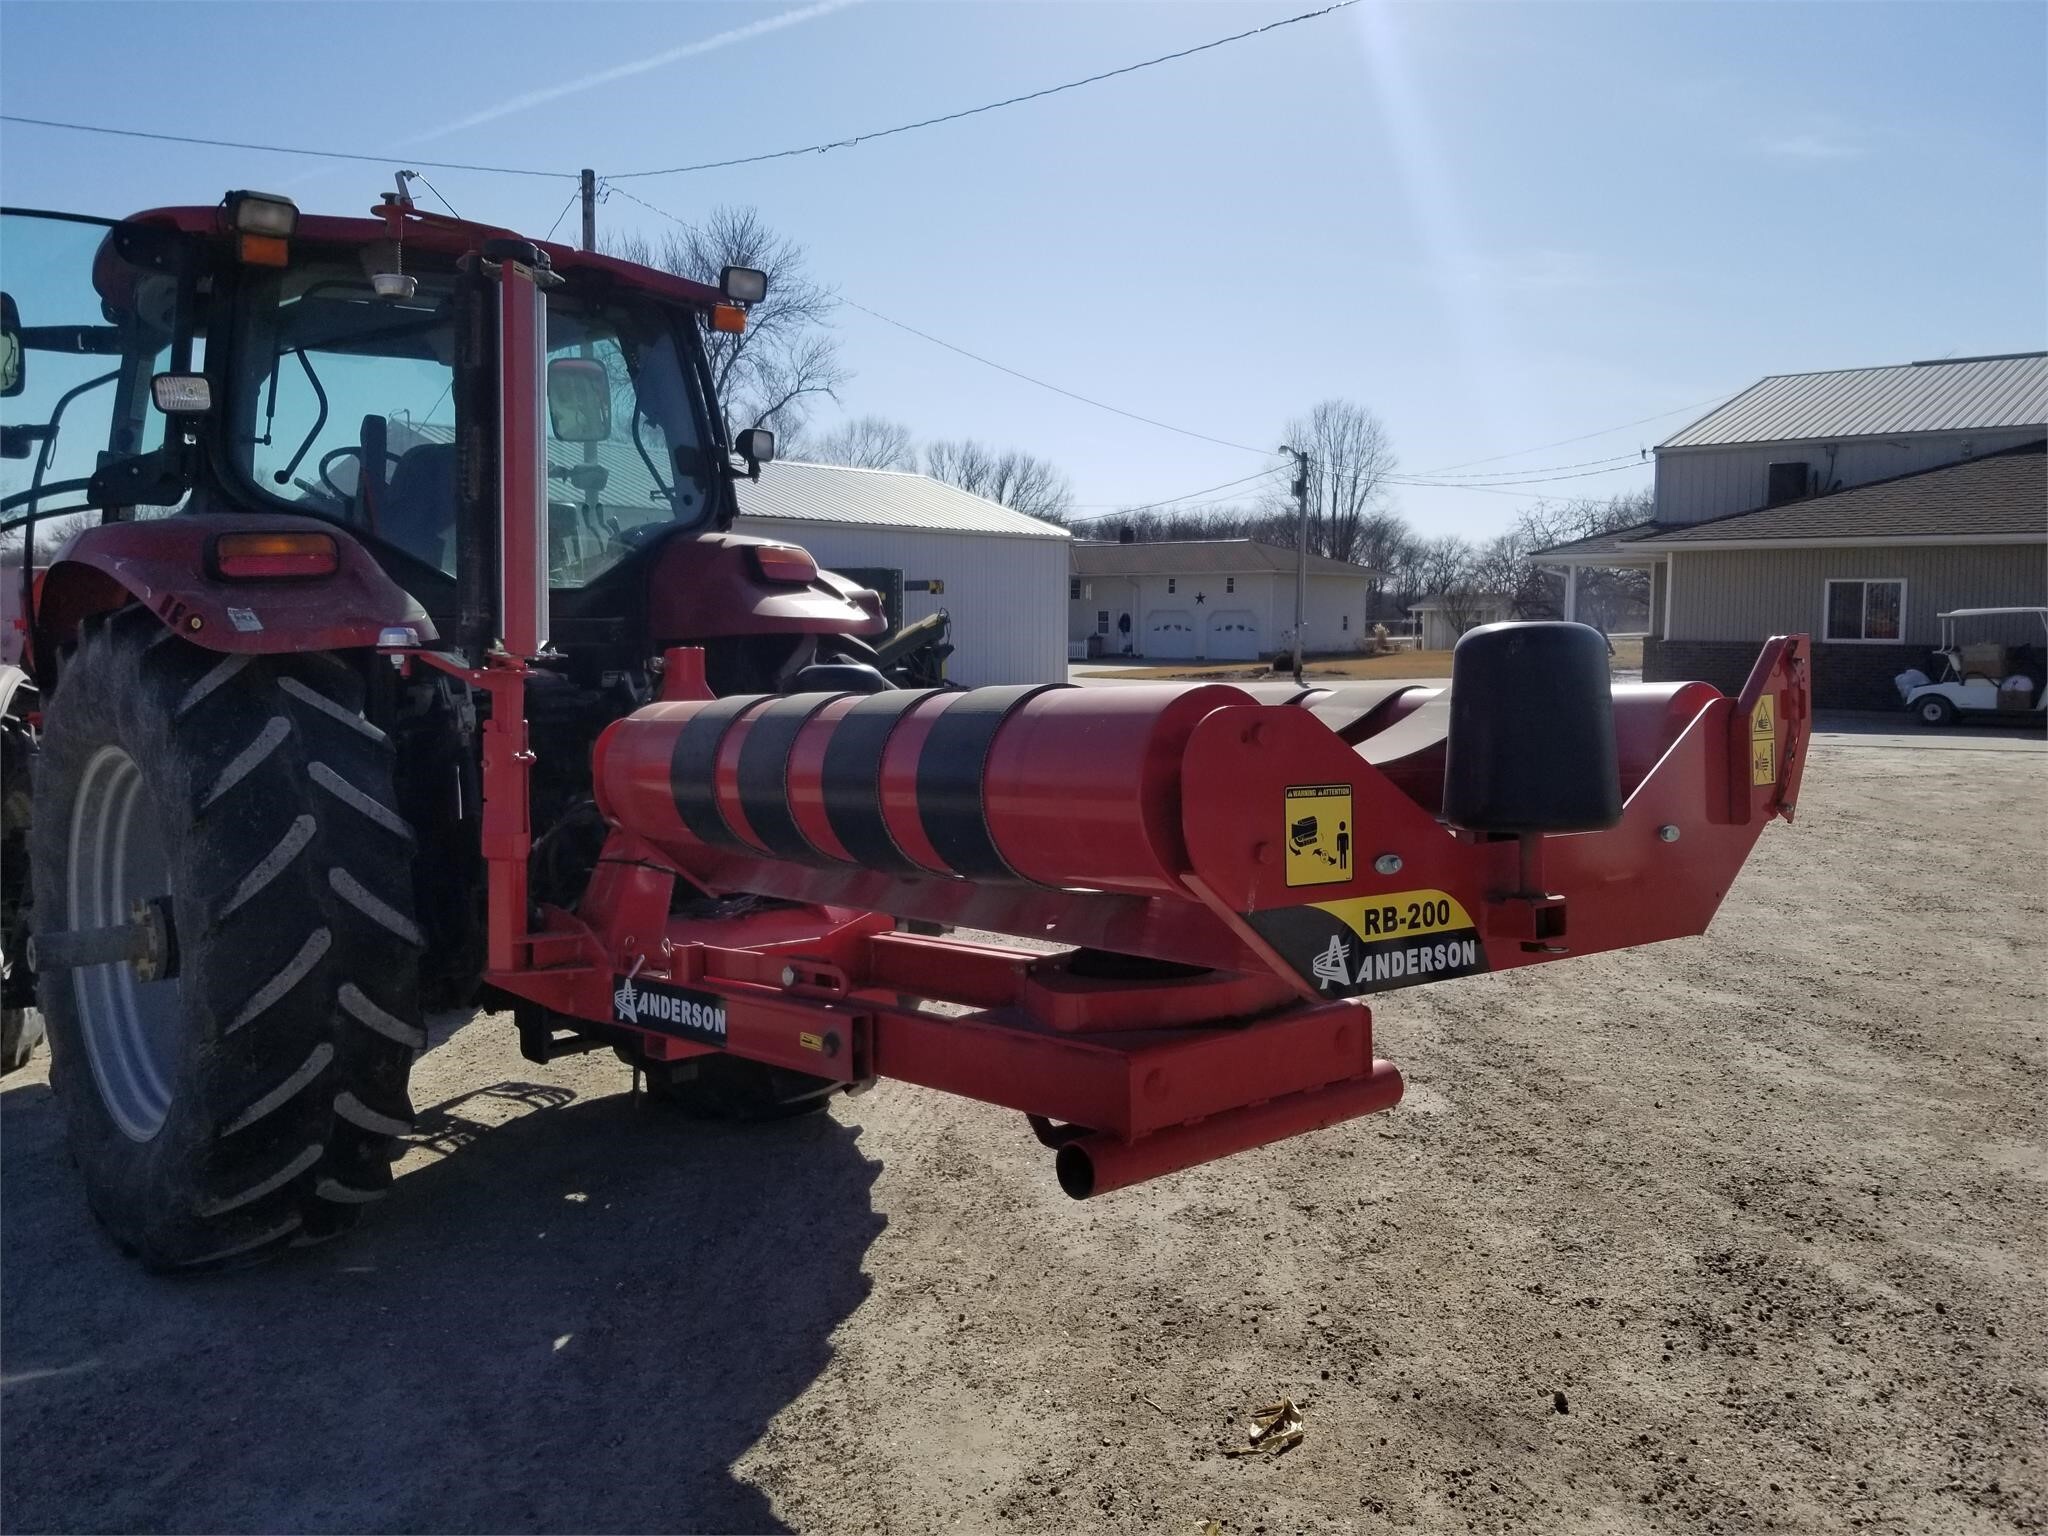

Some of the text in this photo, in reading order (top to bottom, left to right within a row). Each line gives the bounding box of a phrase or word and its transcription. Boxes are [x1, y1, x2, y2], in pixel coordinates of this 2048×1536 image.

[1323, 788, 1350, 796] ATTENTION
[1364, 900, 1450, 936] RB-200
[1355, 939, 1476, 984] ANDERSON
[636, 991, 726, 1034] ANDERSON
